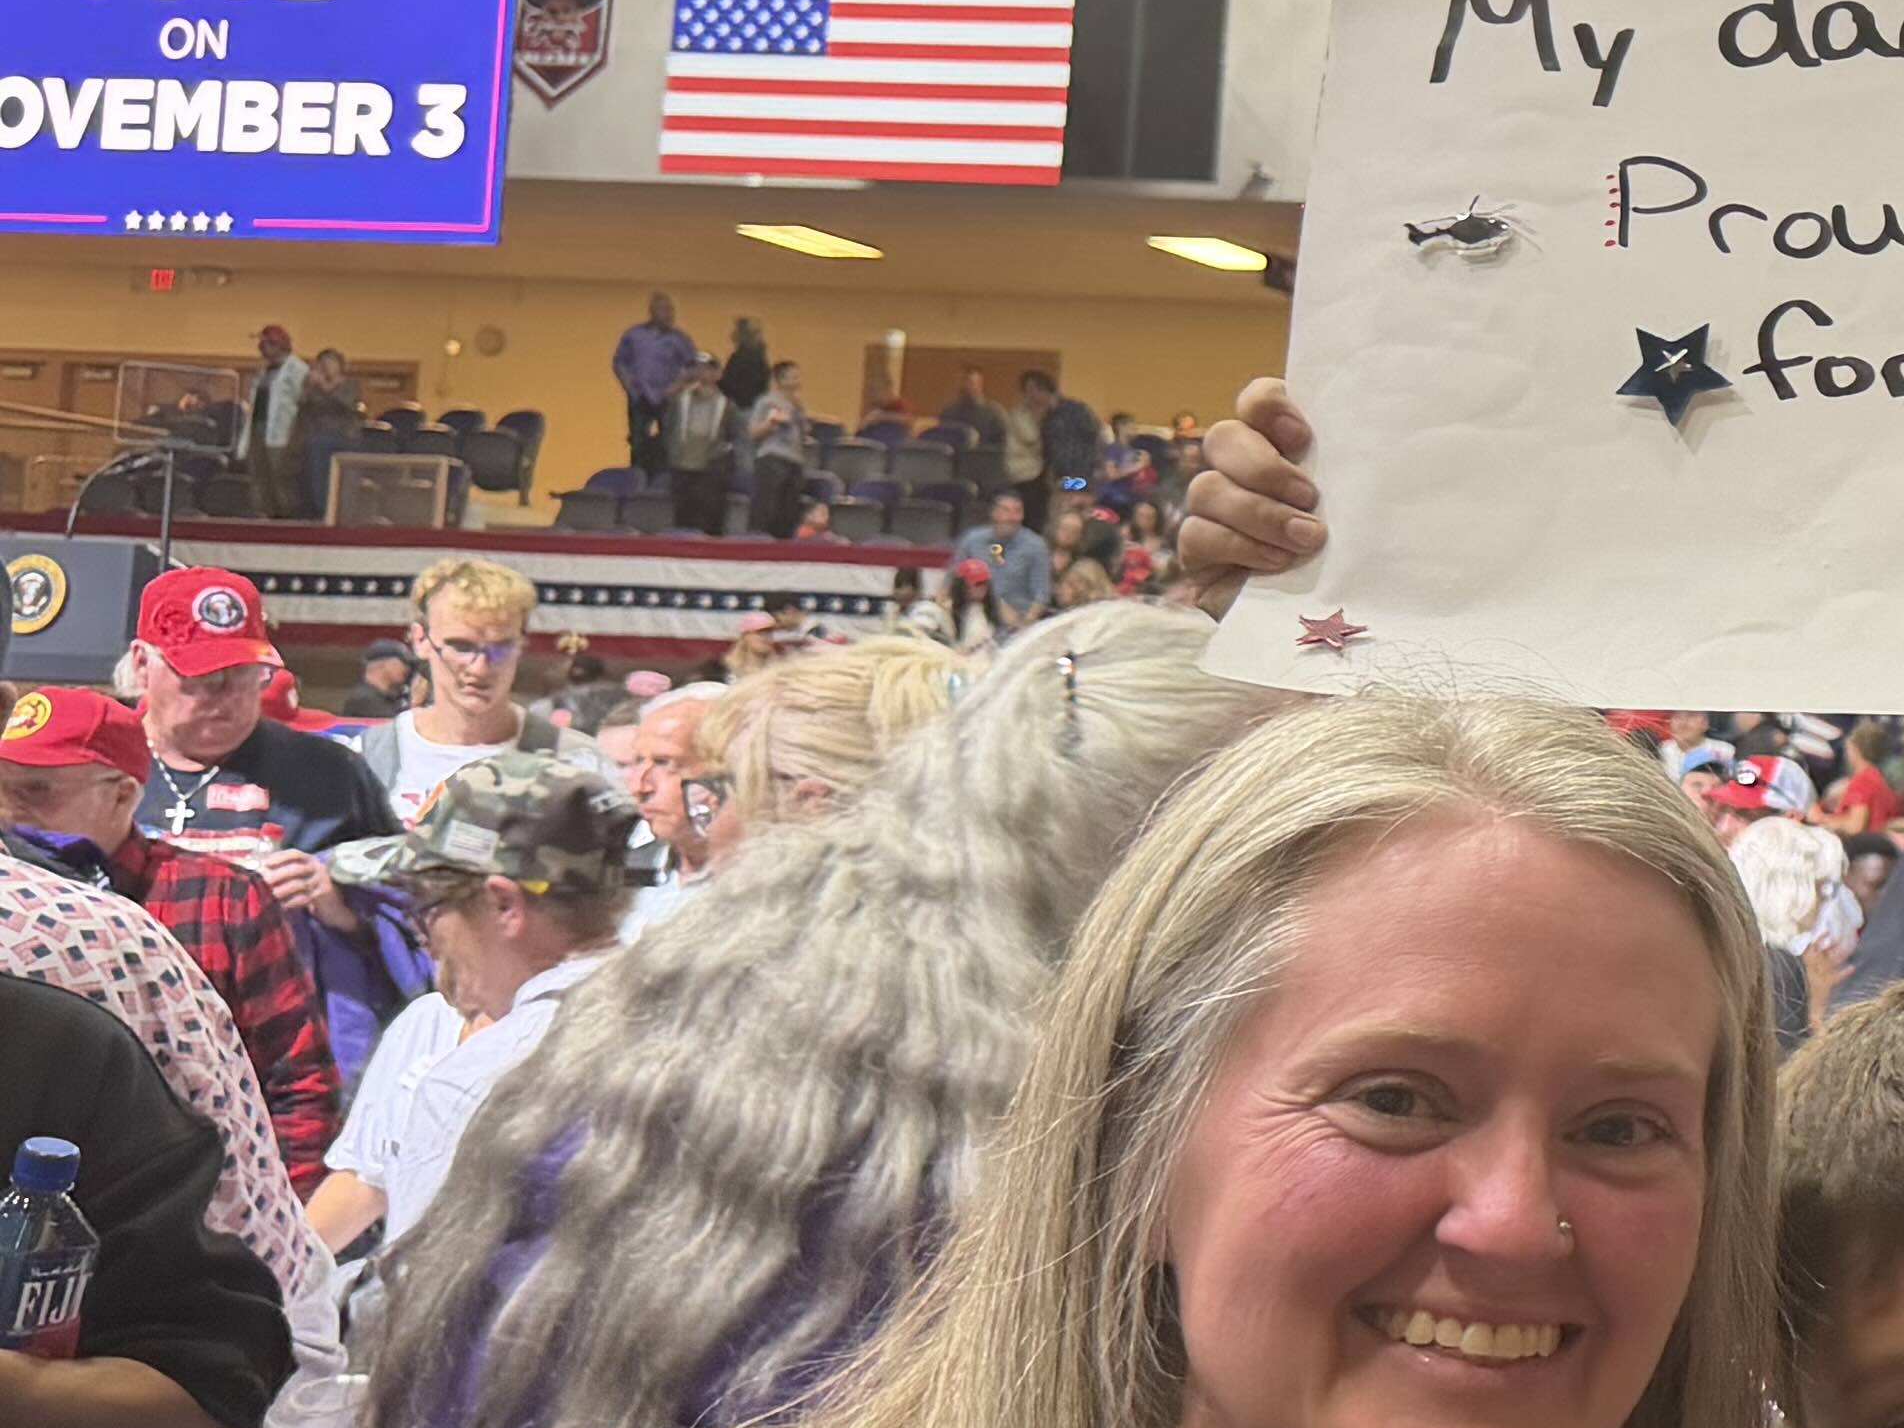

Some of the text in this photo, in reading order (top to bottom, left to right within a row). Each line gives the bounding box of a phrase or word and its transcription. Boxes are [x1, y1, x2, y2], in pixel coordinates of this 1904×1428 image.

[159, 18, 229, 60] ON
[411, 83, 468, 159] 3
[12, 1274, 93, 1330] FIJI
